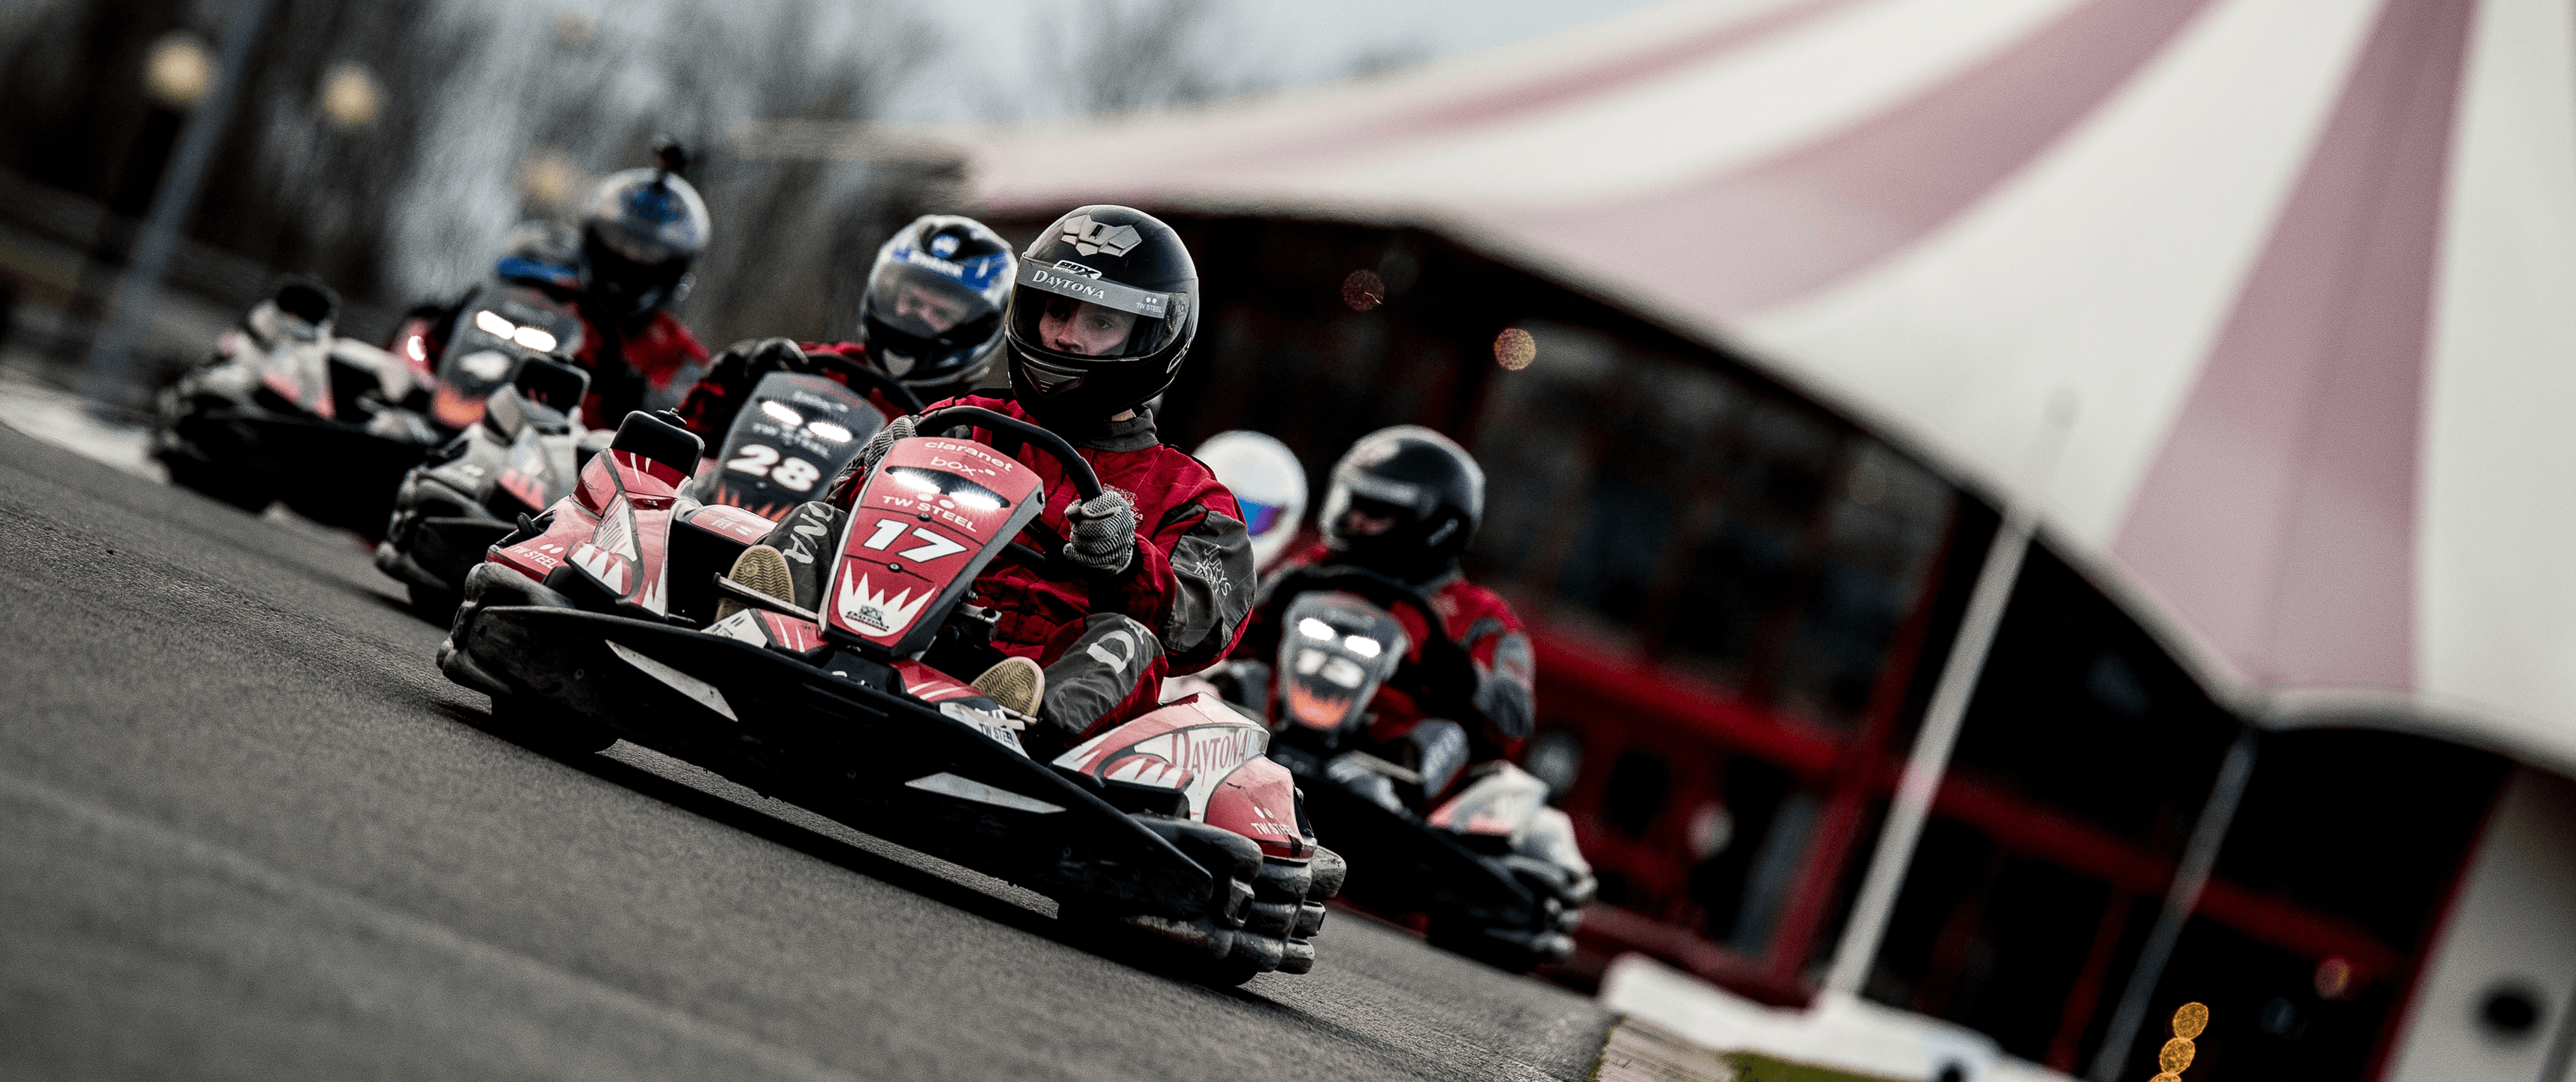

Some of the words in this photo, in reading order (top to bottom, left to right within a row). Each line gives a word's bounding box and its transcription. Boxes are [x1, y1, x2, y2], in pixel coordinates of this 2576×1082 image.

[1032, 270, 1105, 299] DAYTONA
[1146, 304, 1162, 313] STEEL
[727, 444, 821, 492] 28
[924, 441, 1013, 472] claranet
[882, 495, 914, 507] TW
[917, 502, 976, 533] STEEL
[863, 518, 970, 563] 17
[523, 550, 559, 570] STEEL
[979, 722, 992, 739] TW
[1171, 729, 1249, 787] DAYTONA
[1250, 822, 1272, 835] TW
[1267, 822, 1298, 838] STEEL
